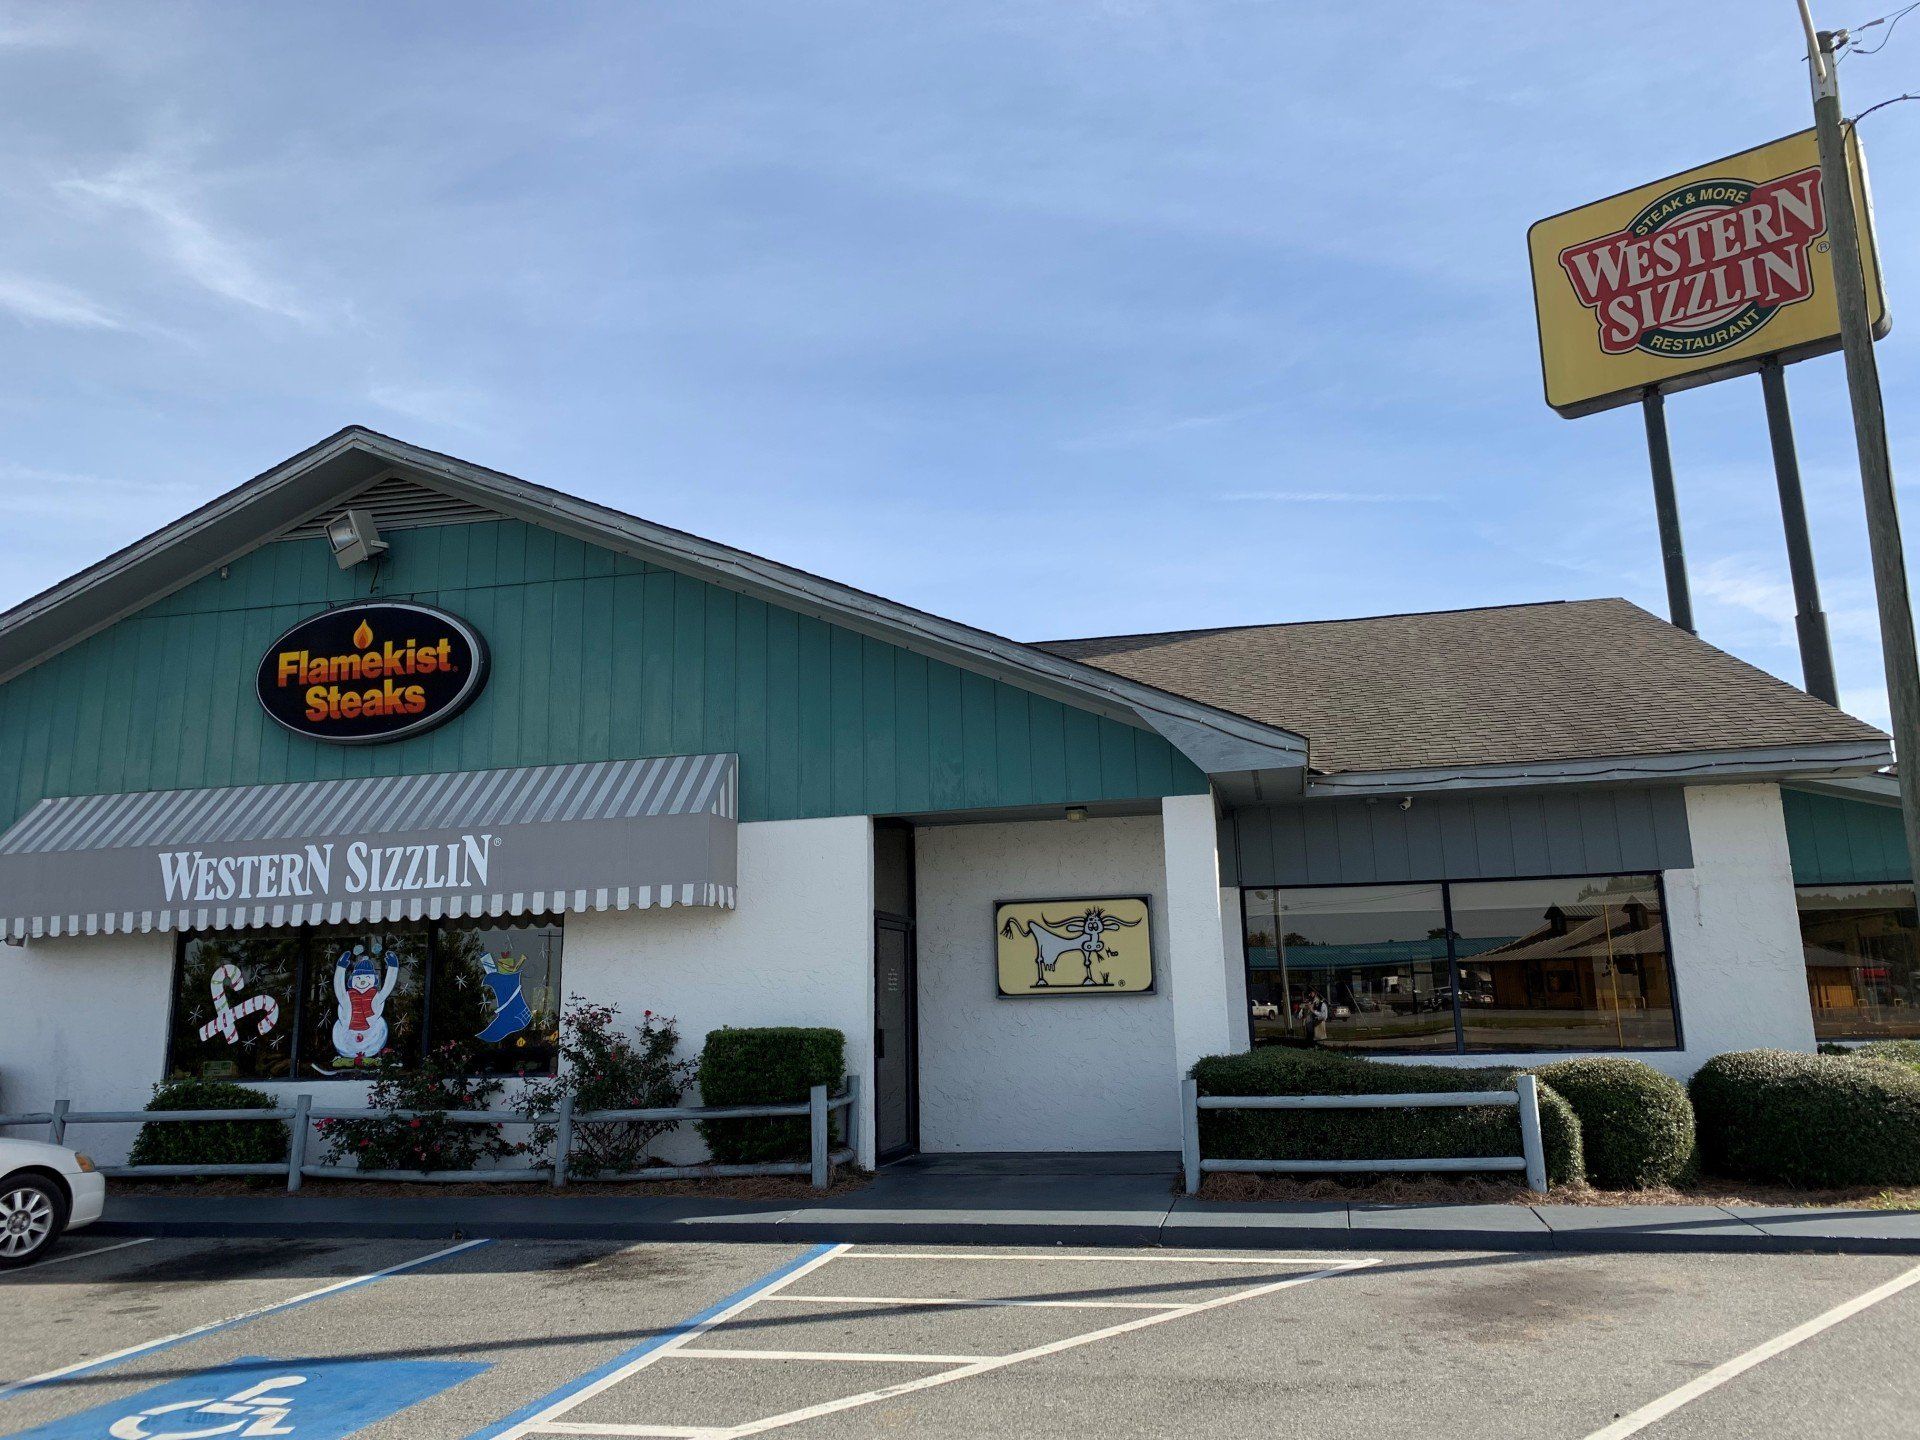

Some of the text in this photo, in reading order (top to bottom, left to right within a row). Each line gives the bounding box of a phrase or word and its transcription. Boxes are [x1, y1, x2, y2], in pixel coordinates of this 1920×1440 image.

[1636, 187, 1748, 236] STEAK & MORE
[1571, 179, 1816, 298] WESTERN
[1607, 243, 1802, 343] SIZZLIN
[1650, 308, 1760, 351] RESTAURANT
[277, 637, 452, 688] Flamekist
[305, 678, 426, 722] Steaks
[158, 834, 492, 902] WESTERN SIZZLIN
